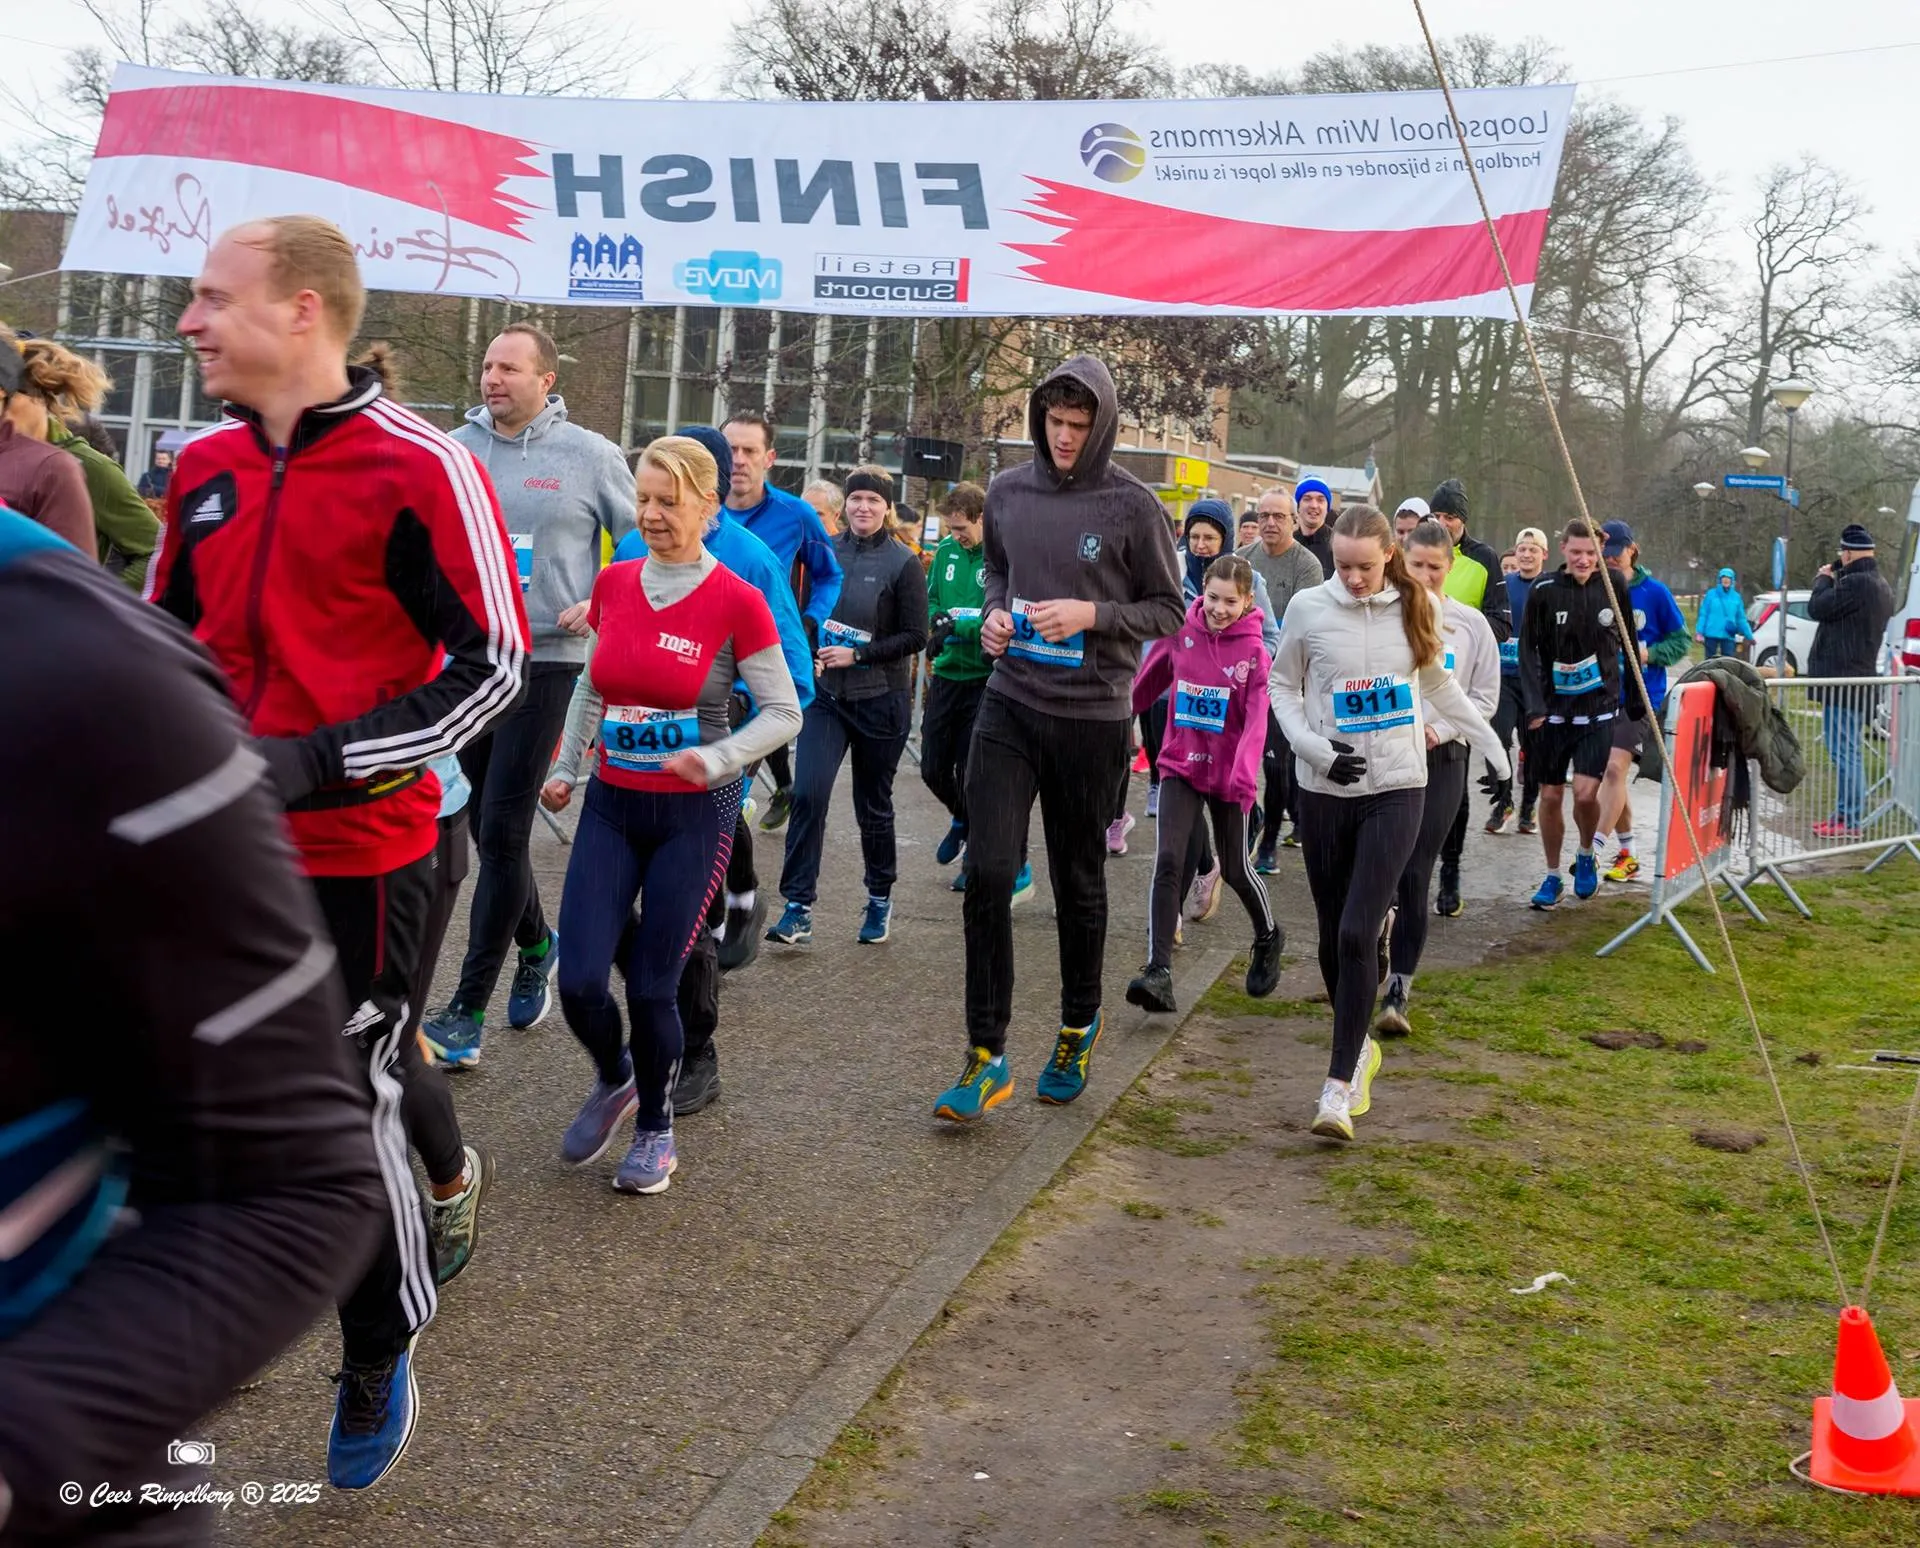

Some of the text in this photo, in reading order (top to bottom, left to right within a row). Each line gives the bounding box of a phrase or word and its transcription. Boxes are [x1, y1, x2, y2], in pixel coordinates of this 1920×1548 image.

[945, 562, 956, 581] 8
[1555, 611, 1568, 625] 17
[1560, 668, 1593, 685] 733
[1186, 696, 1222, 718] 763
[1345, 688, 1398, 714] 911
[615, 723, 684, 751] 840
